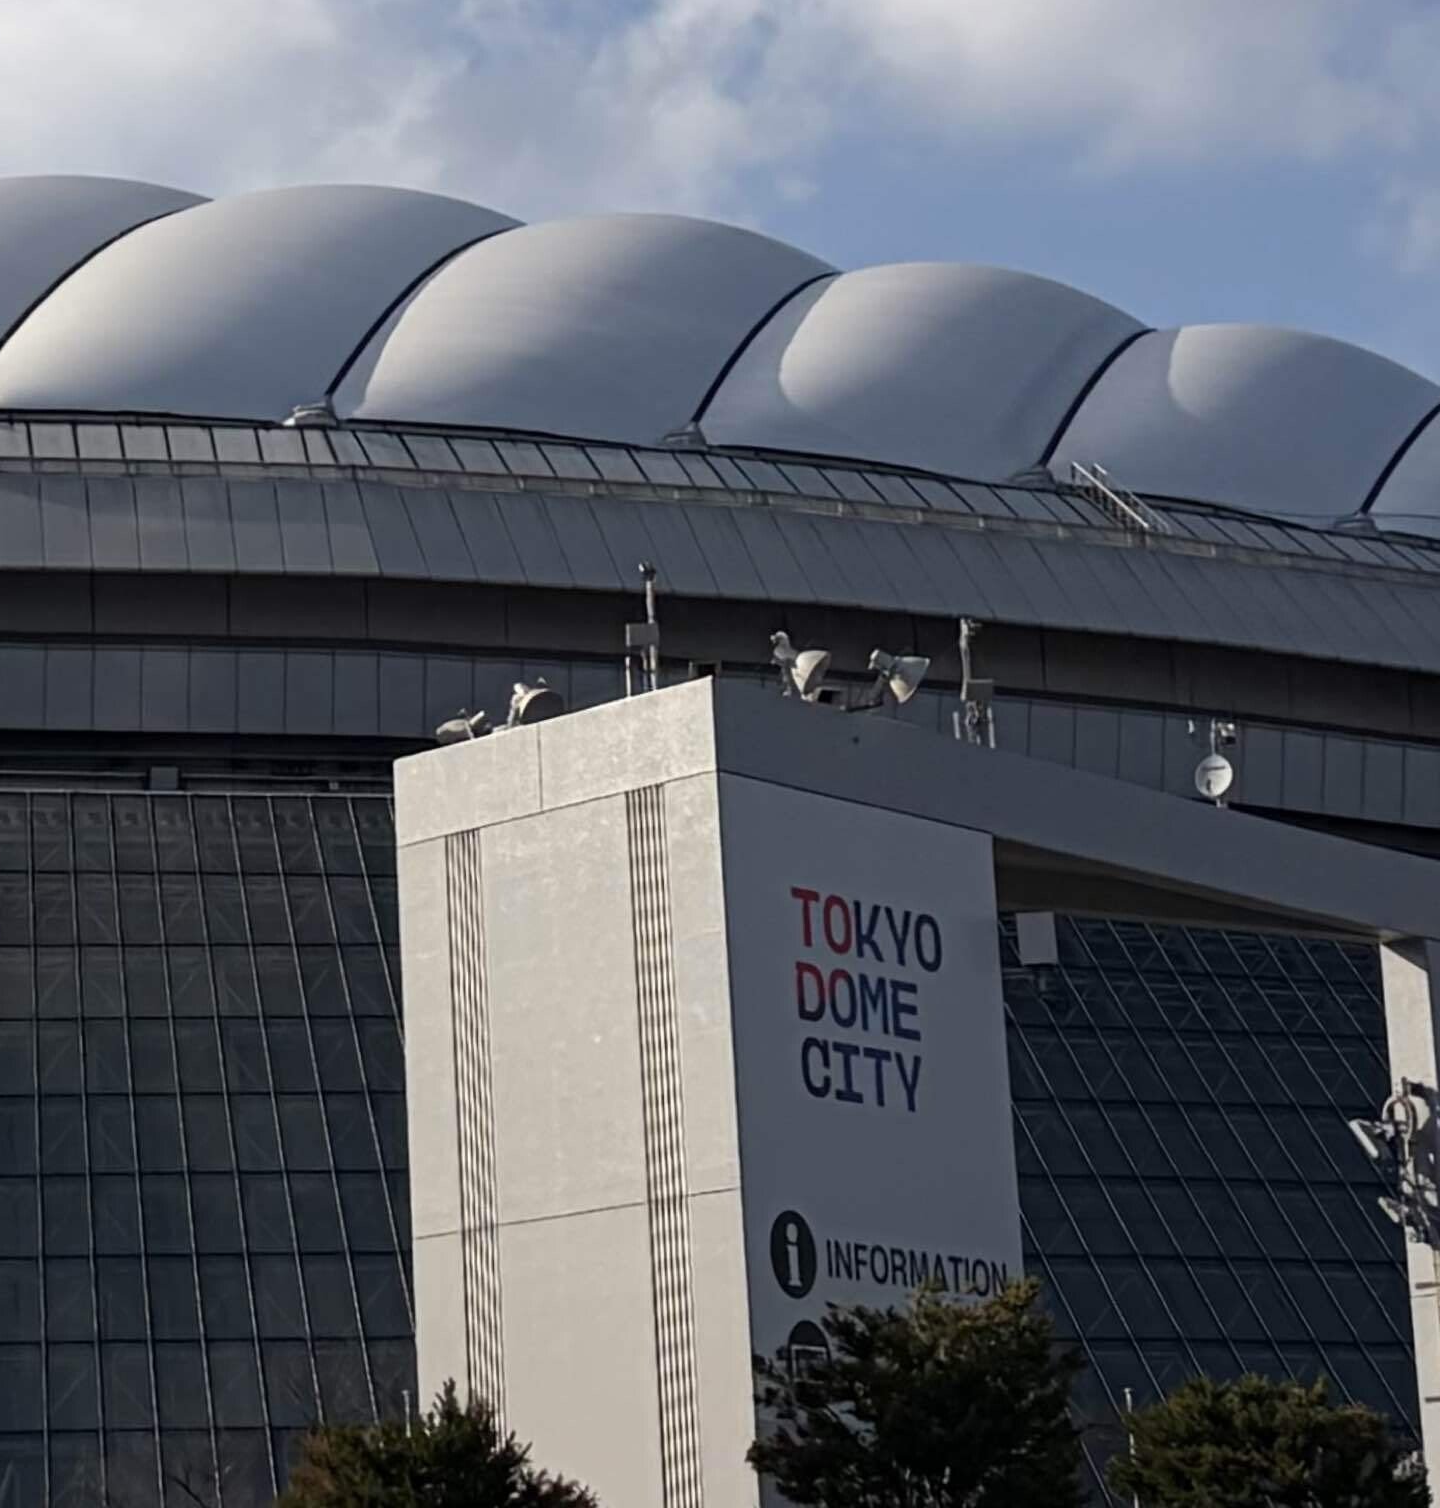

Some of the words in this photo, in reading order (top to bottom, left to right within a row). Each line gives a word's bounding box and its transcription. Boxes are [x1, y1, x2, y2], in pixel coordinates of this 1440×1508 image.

[790, 886, 943, 973] TOKYO
[795, 960, 922, 1042] DOME
[800, 1036, 922, 1113] CITY
[825, 1238, 1008, 1298] INFORMATION
